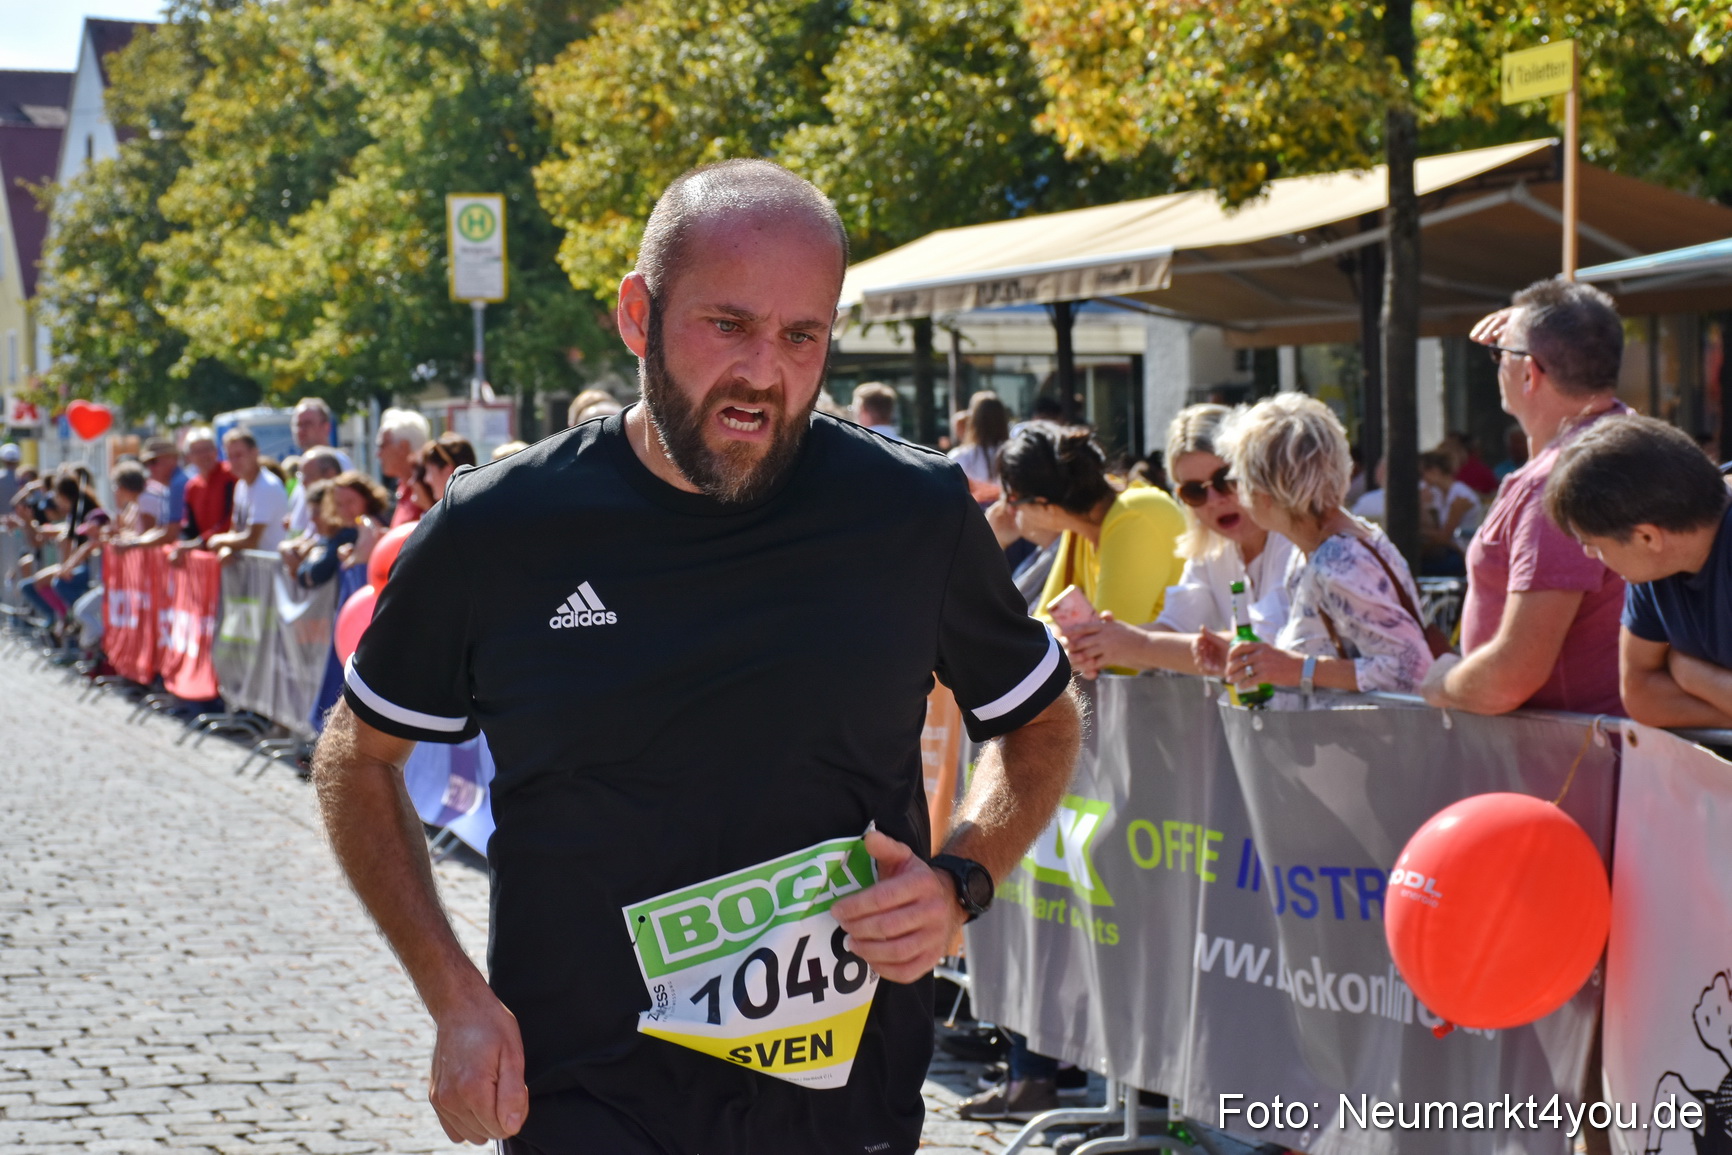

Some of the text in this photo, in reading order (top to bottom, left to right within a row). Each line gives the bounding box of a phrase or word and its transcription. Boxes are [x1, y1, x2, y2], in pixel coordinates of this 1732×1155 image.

[1516, 62, 1568, 86] Toiletten
[549, 608, 618, 630] adidas
[690, 926, 868, 1026] 1048
[725, 1029, 834, 1067] SVEN
